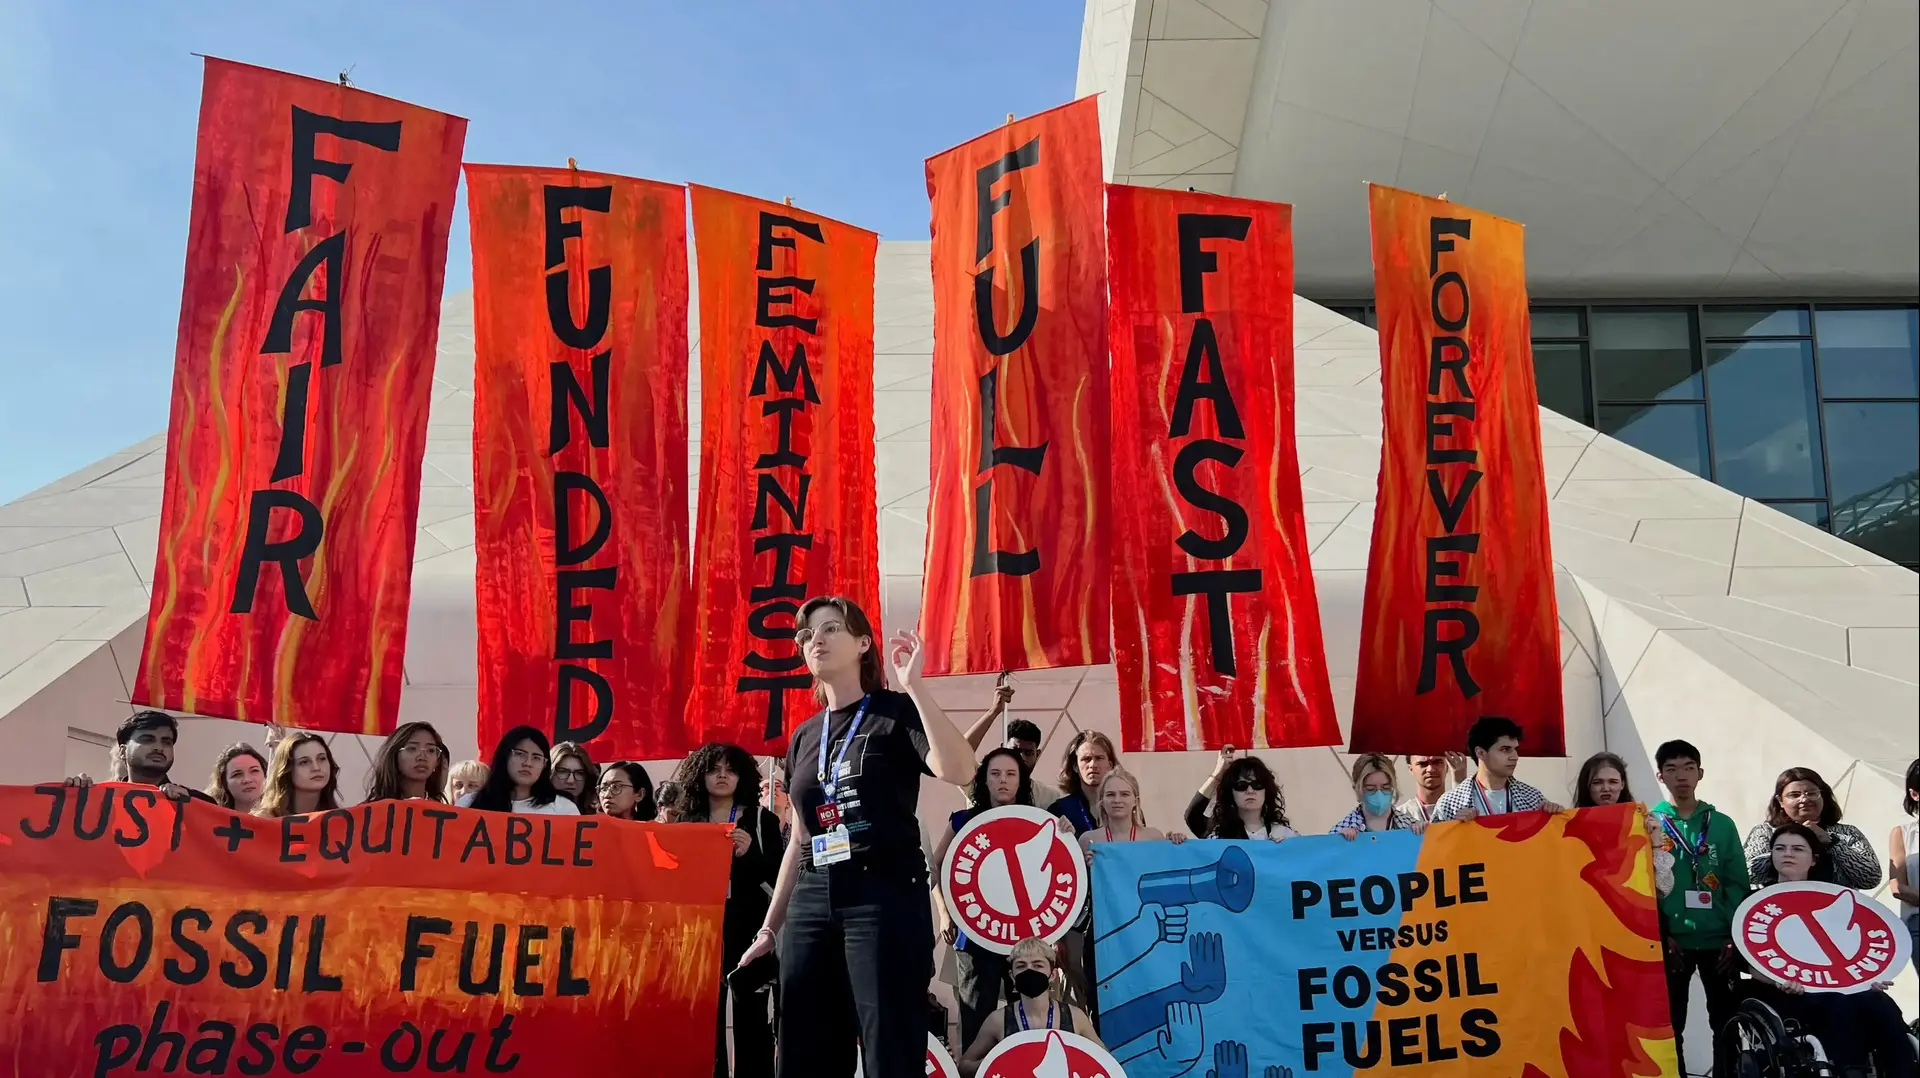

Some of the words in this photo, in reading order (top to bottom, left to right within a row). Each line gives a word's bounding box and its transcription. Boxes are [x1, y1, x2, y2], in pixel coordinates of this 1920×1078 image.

[230, 104, 402, 621] FAIR
[969, 135, 1049, 578] FULL
[543, 185, 616, 746] FUNDED
[736, 211, 825, 740] FEMINIST
[1169, 213, 1262, 677] FAST
[1416, 217, 1483, 698] FOREVER
[20, 786, 190, 851] JUST
[279, 804, 599, 867] EQUITABLE
[954, 833, 991, 885] #END
[1290, 862, 1488, 919] PEOPLE
[958, 892, 1020, 941] FOSSIL
[1029, 872, 1073, 937] FUELS
[1336, 920, 1449, 952] VERSUS
[1747, 903, 1783, 944] #END
[37, 896, 344, 993] FOSSIL
[400, 913, 590, 996] FUEL
[1757, 948, 1838, 985] FOSSIL
[1845, 928, 1890, 981] FUELS
[1297, 952, 1498, 1010] FOSSIL
[1302, 1008, 1501, 1071] FUELS
